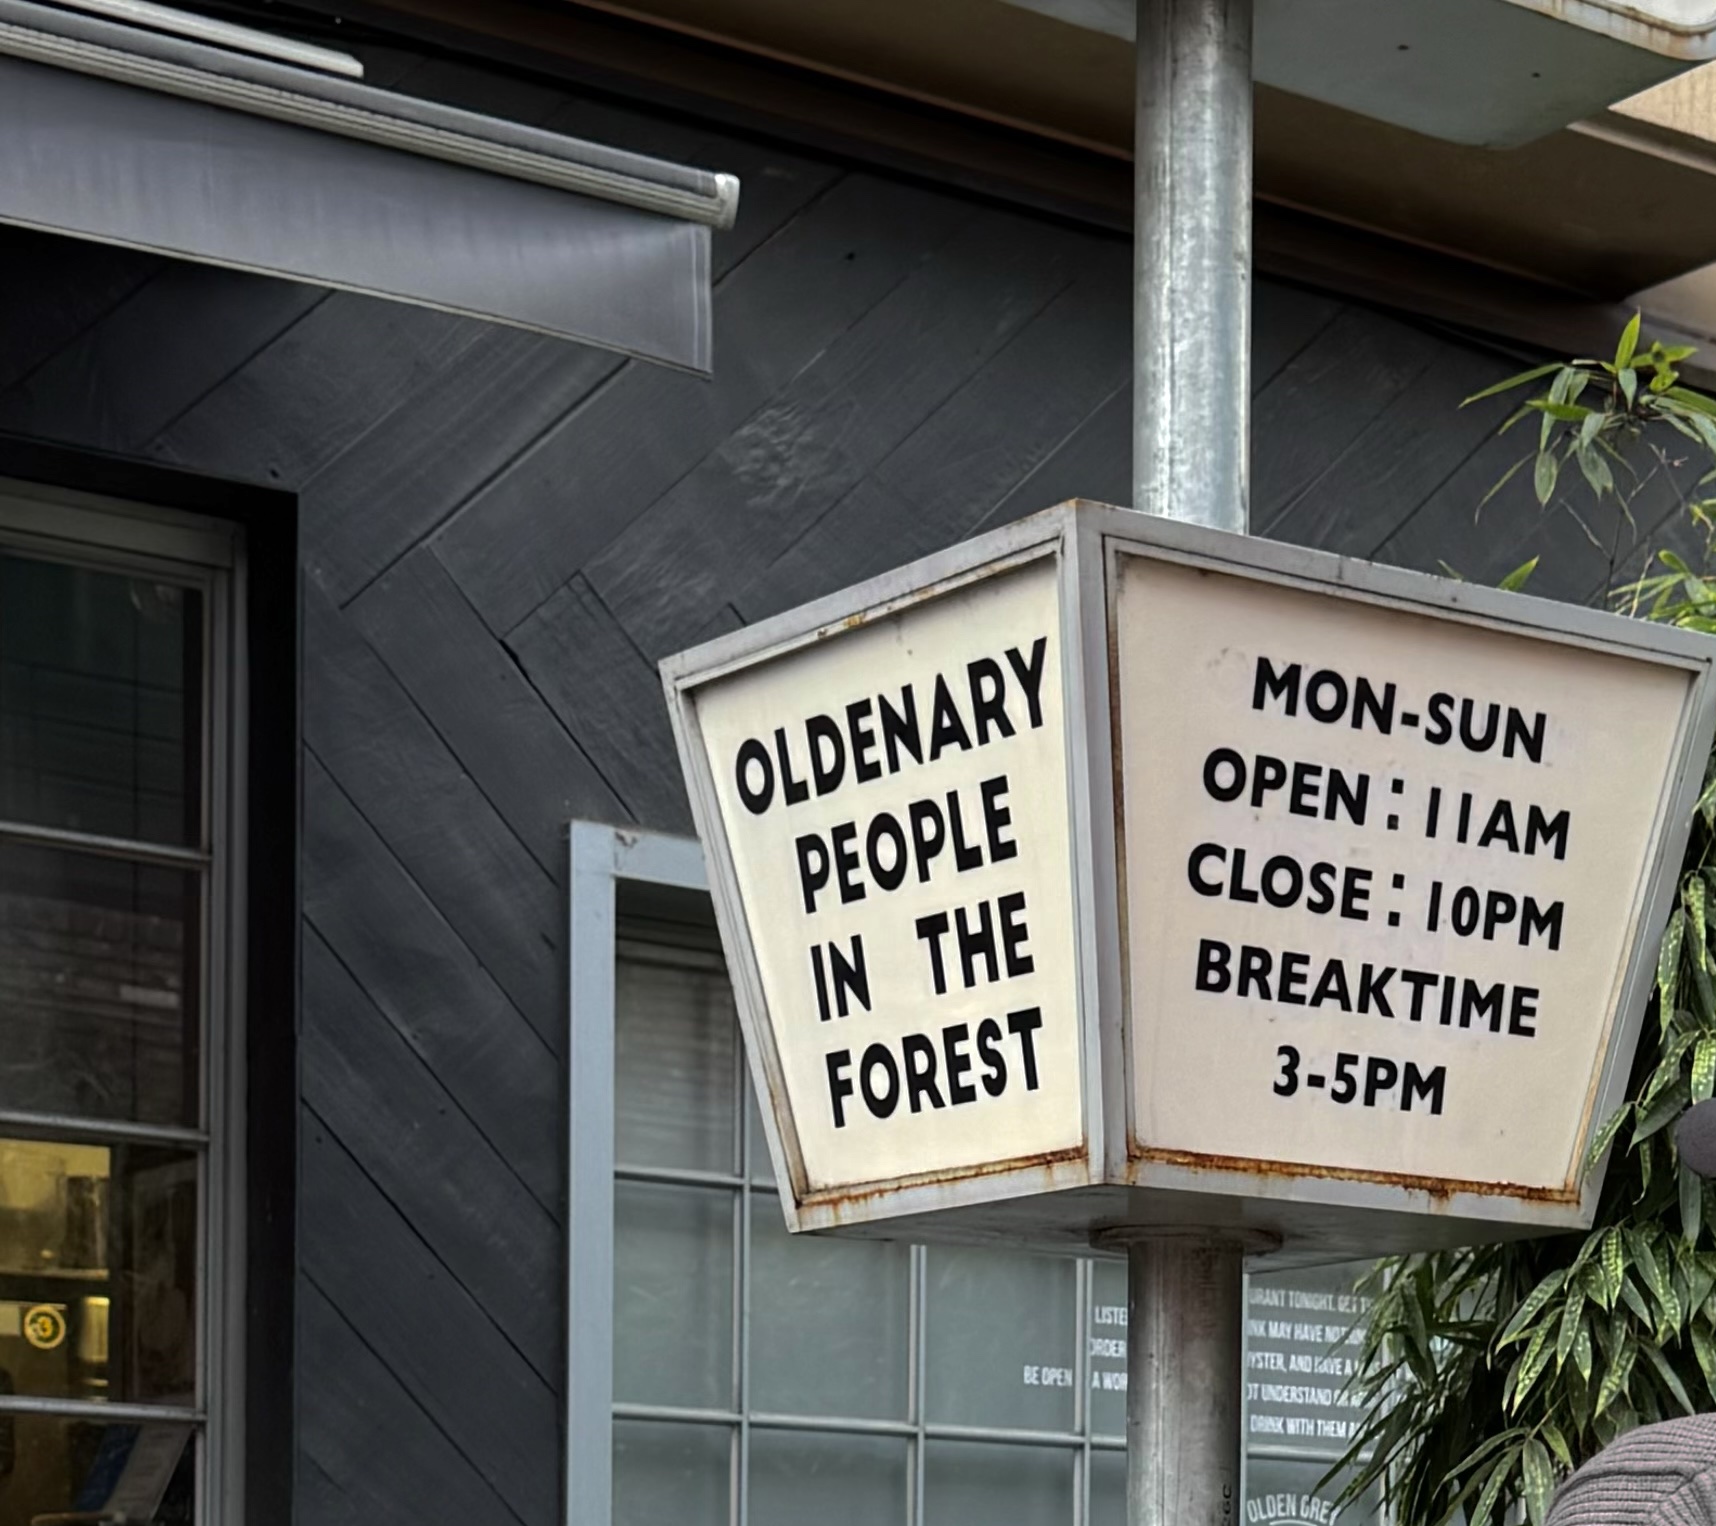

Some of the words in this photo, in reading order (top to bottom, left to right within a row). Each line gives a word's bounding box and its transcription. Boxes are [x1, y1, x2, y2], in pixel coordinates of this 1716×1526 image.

[735, 637, 1047, 815] OLDENARY
[1252, 656, 1547, 764] MON-SUN
[1203, 747, 1370, 826] OPEN
[795, 775, 1018, 914] PEOPLE
[1187, 842, 1373, 921] CLOSE
[810, 934, 871, 1022] IN
[915, 891, 1035, 995] THE
[1195, 938, 1540, 1038] BREAKTIME
[825, 1006, 1042, 1128] FOREST
[1273, 1045, 1447, 1115] 3-5PM
[1095, 1305, 1128, 1326] LISTE
[1024, 1365, 1040, 1386] BE
[1041, 1366, 1073, 1387] OPEN
[1102, 1371, 1128, 1392] WOR
[1246, 1493, 1297, 1524] OLDEN
